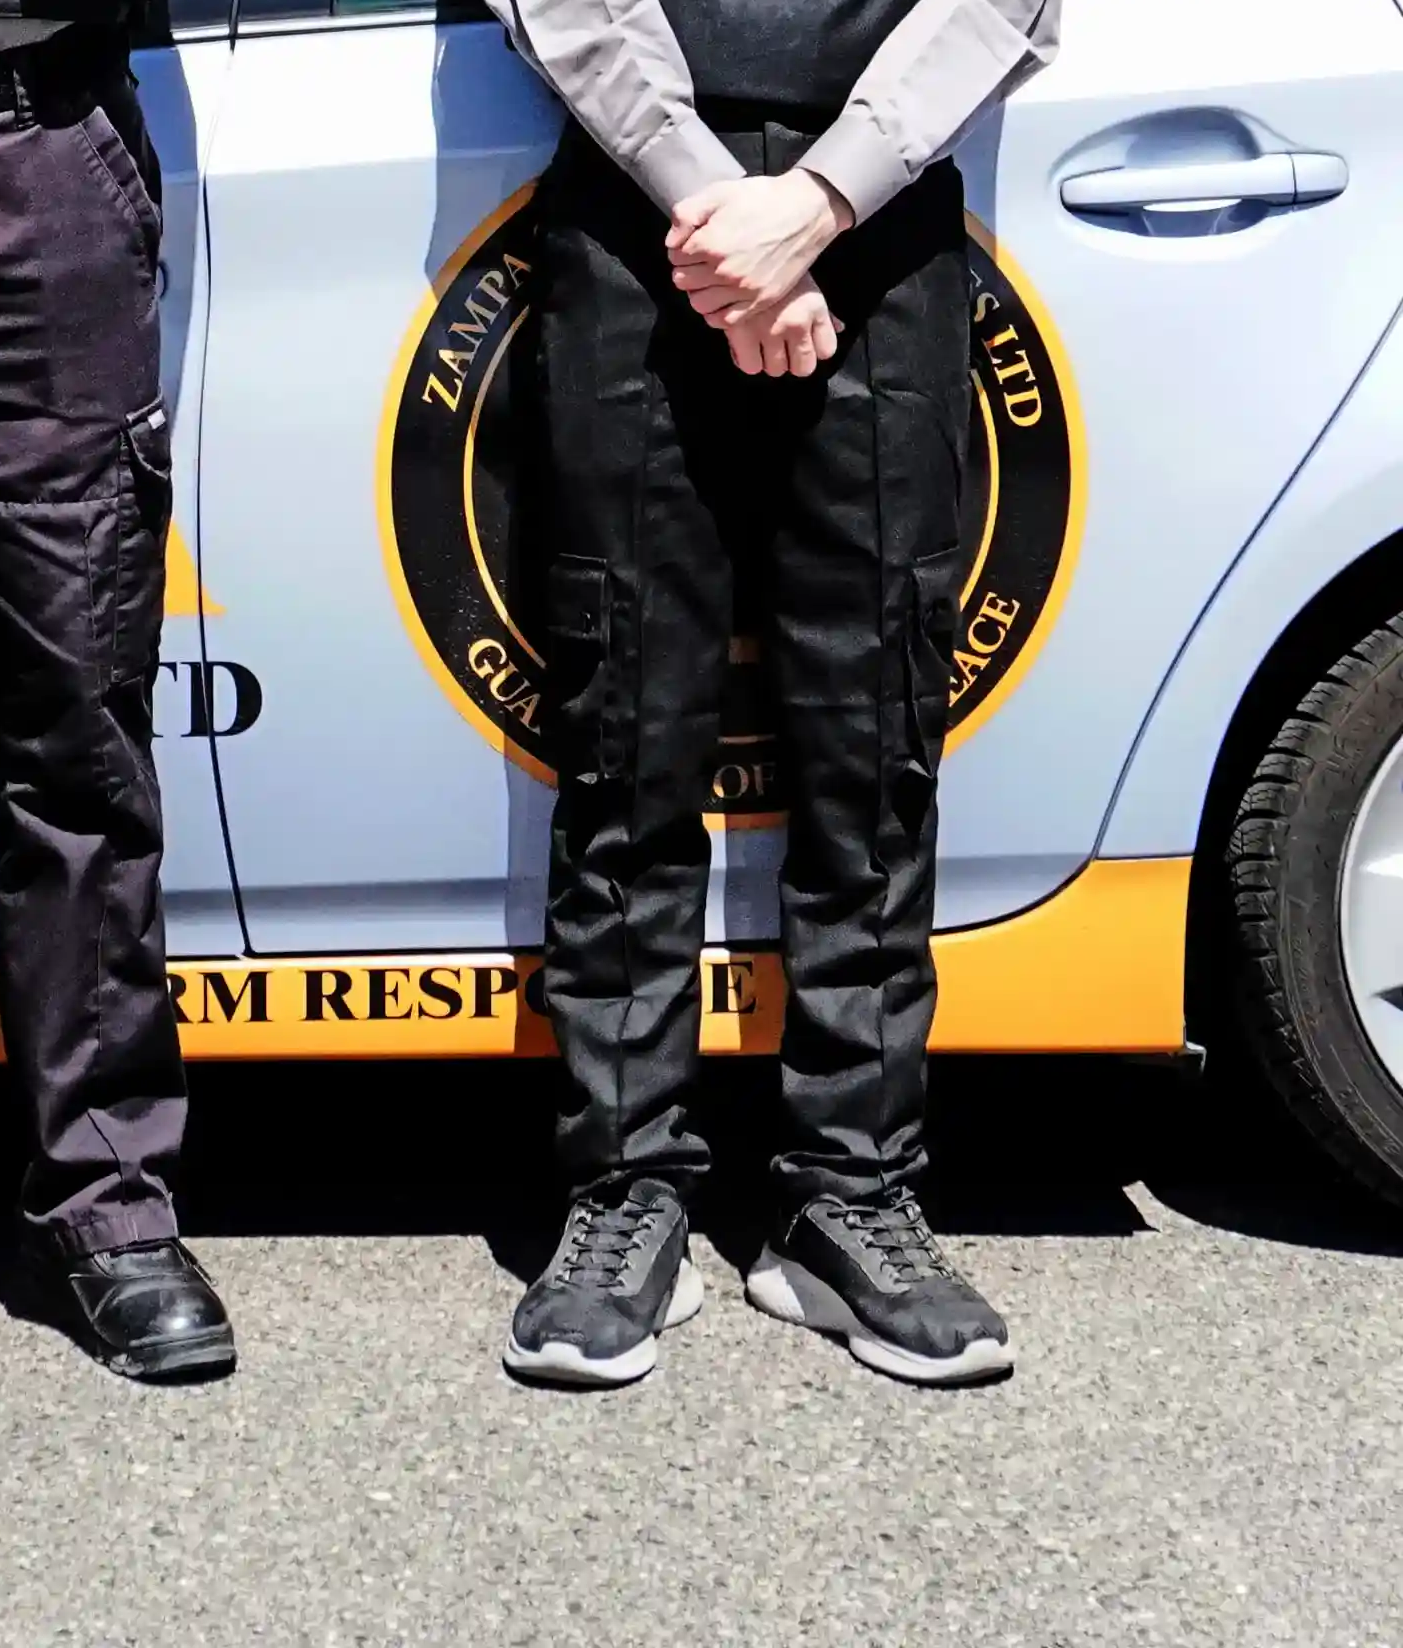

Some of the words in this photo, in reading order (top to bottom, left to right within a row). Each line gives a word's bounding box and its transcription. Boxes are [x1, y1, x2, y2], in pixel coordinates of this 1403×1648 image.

[421, 252, 533, 413] ZAMPA
[980, 324, 1043, 428] LTD
[299, 961, 757, 1021] RESPE
